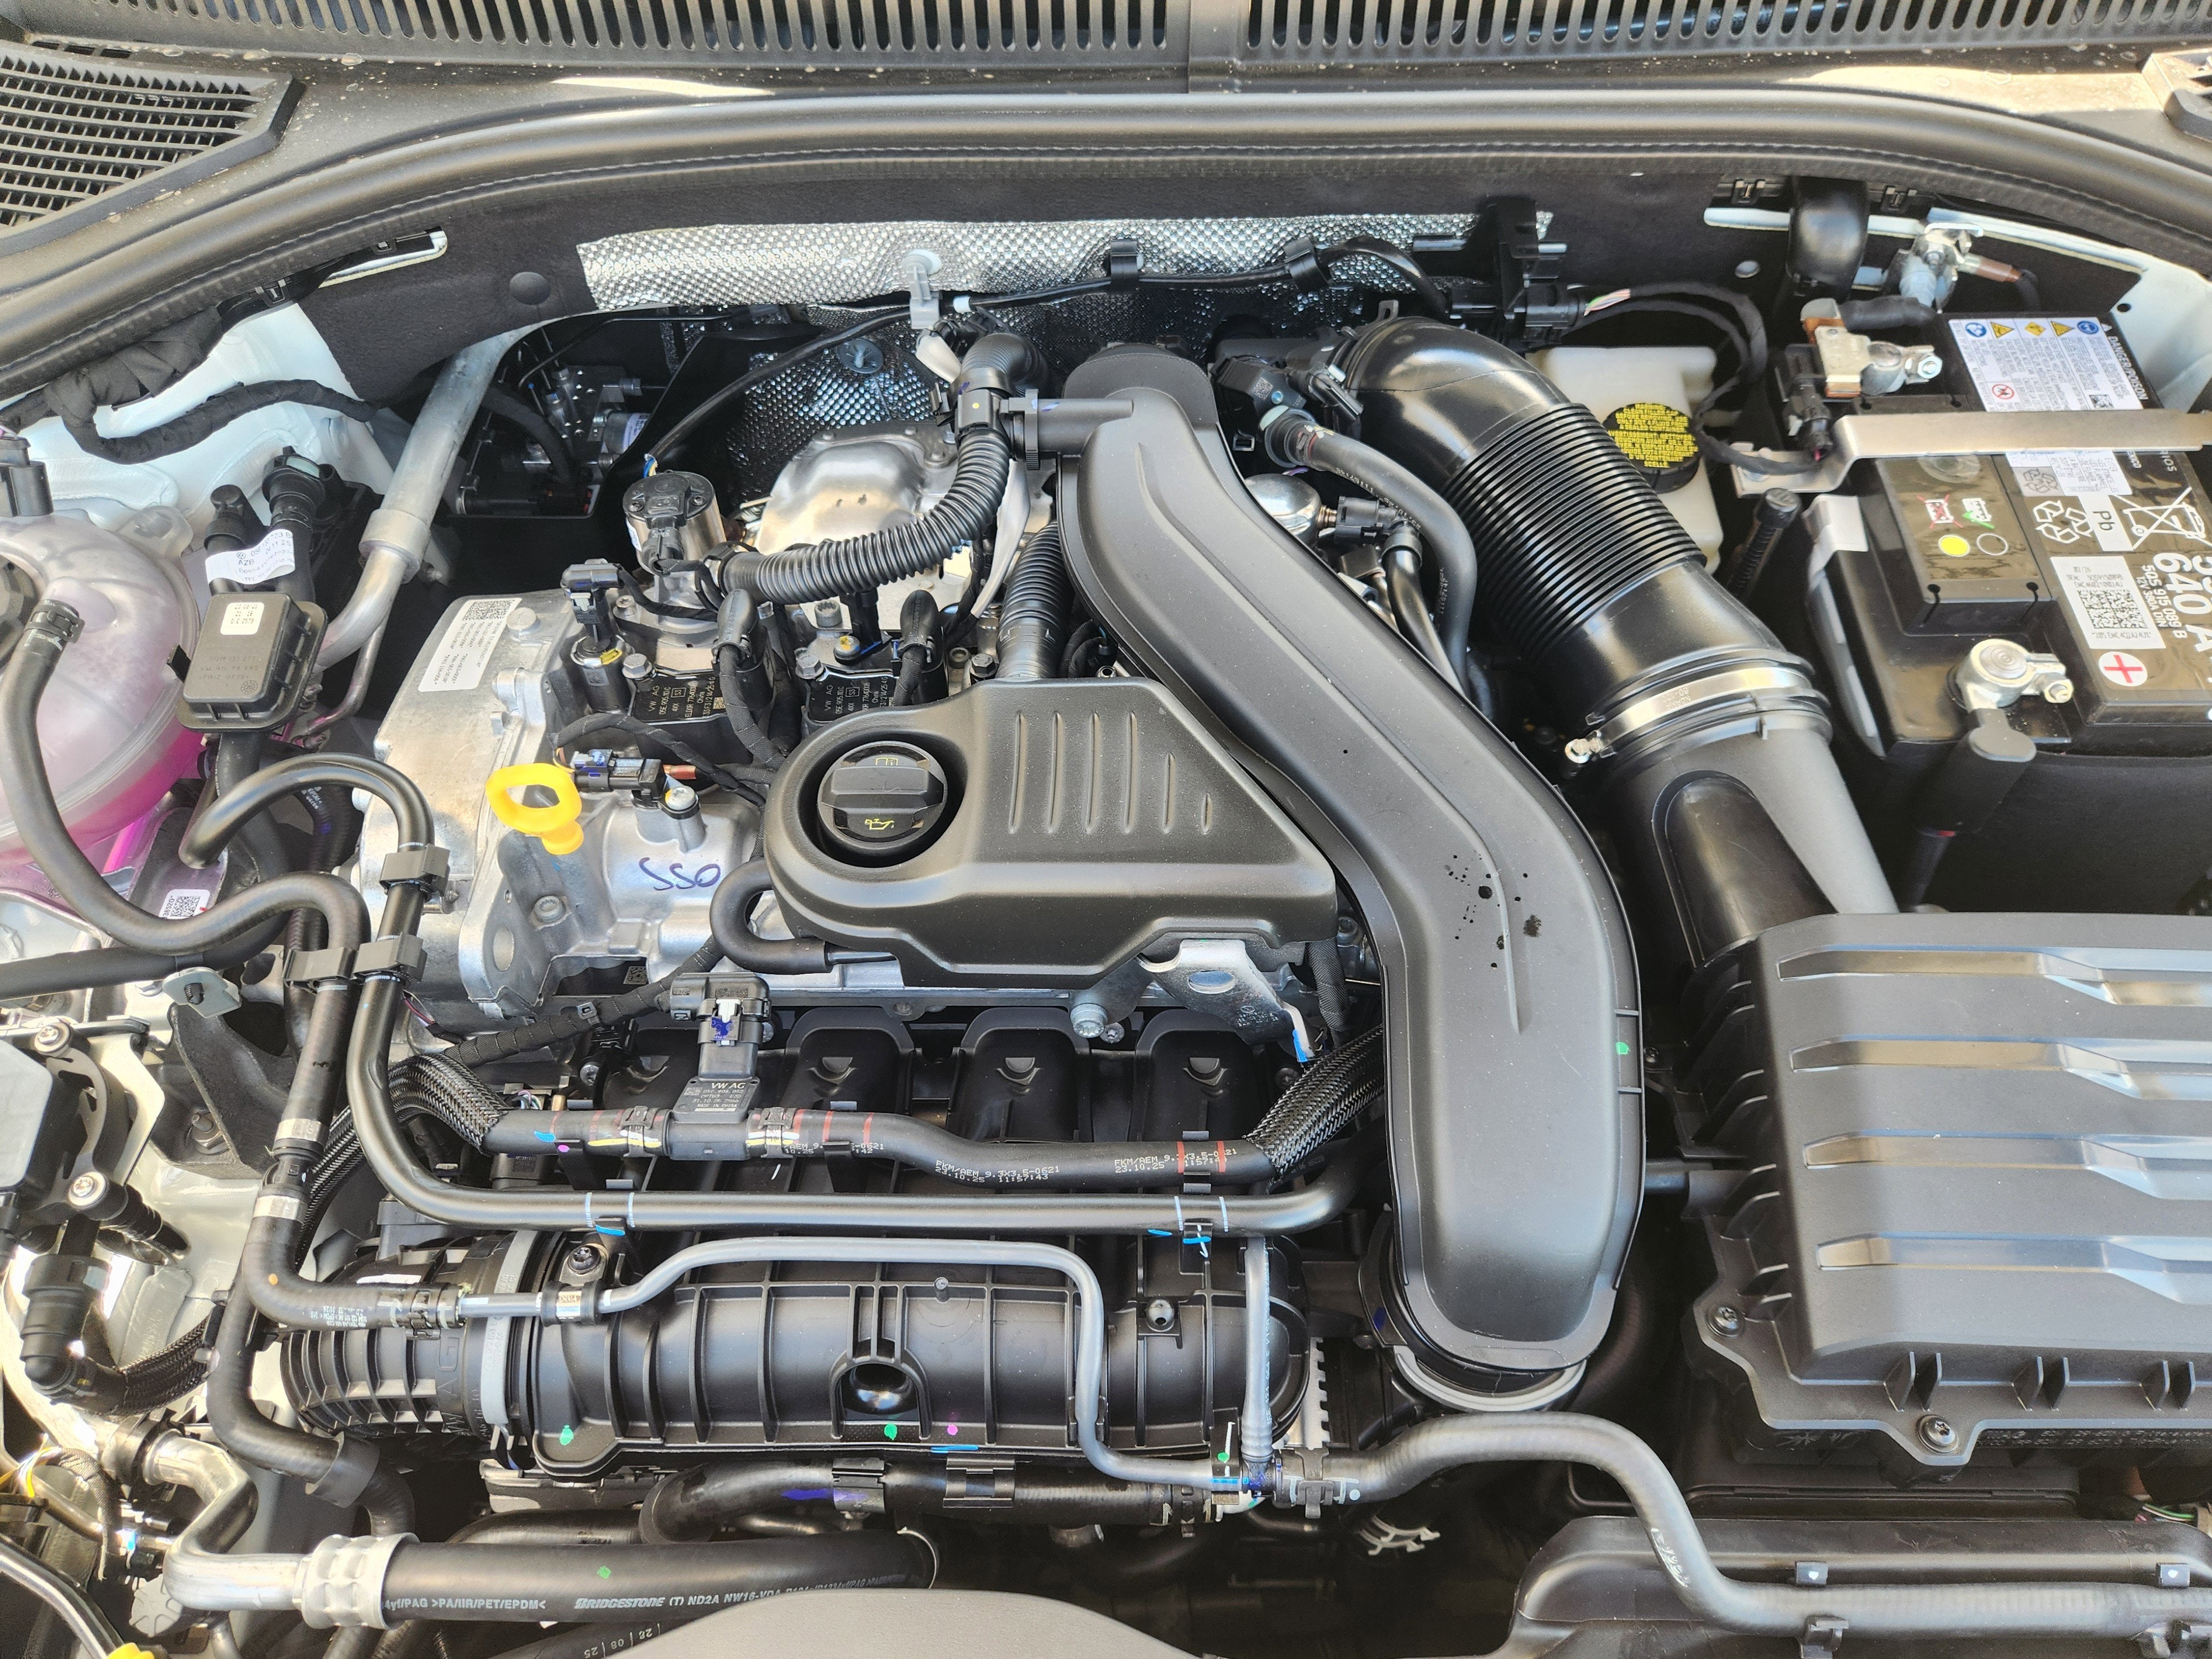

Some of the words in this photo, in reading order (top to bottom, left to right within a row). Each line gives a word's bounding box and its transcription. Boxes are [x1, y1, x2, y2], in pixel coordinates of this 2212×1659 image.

[2107, 336, 2149, 399] DANGER/POISON
[2125, 451, 2142, 468] EXICO
[2093, 510, 2116, 530] Pb
[2136, 576, 2151, 590] 12V
[2141, 565, 2162, 588] 5QS
[2153, 553, 2212, 615] 640
[2143, 590, 2159, 611] 380A
[2154, 588, 2172, 606] 915
[2153, 612, 2169, 628] DIN
[2162, 608, 2182, 628] 089
[2173, 630, 2188, 638] B
[650, 685, 662, 695] AG
[696, 691, 706, 703] China
[823, 685, 836, 695] AG
[871, 691, 881, 702] China
[646, 701, 658, 711] VW
[683, 703, 695, 717] ELDOR
[821, 700, 834, 711] VW
[1114, 1156, 1158, 1166] FKM/AEM
[1115, 1161, 1165, 1173] 23.10.25
[935, 1166, 985, 1183] 23.10.25
[999, 1173, 1048, 1183] 11:57:43
[936, 1160, 979, 1177] FKM/AEM
[431, 1598, 546, 1610] >PA/IIR/PET/EPDM<
[574, 1597, 666, 1610] BRIDGESTONE
[669, 1596, 685, 1606] (T)
[687, 1595, 719, 1606] ND2A
[611, 1638, 624, 1650] 08
[583, 1646, 598, 1658] 25
